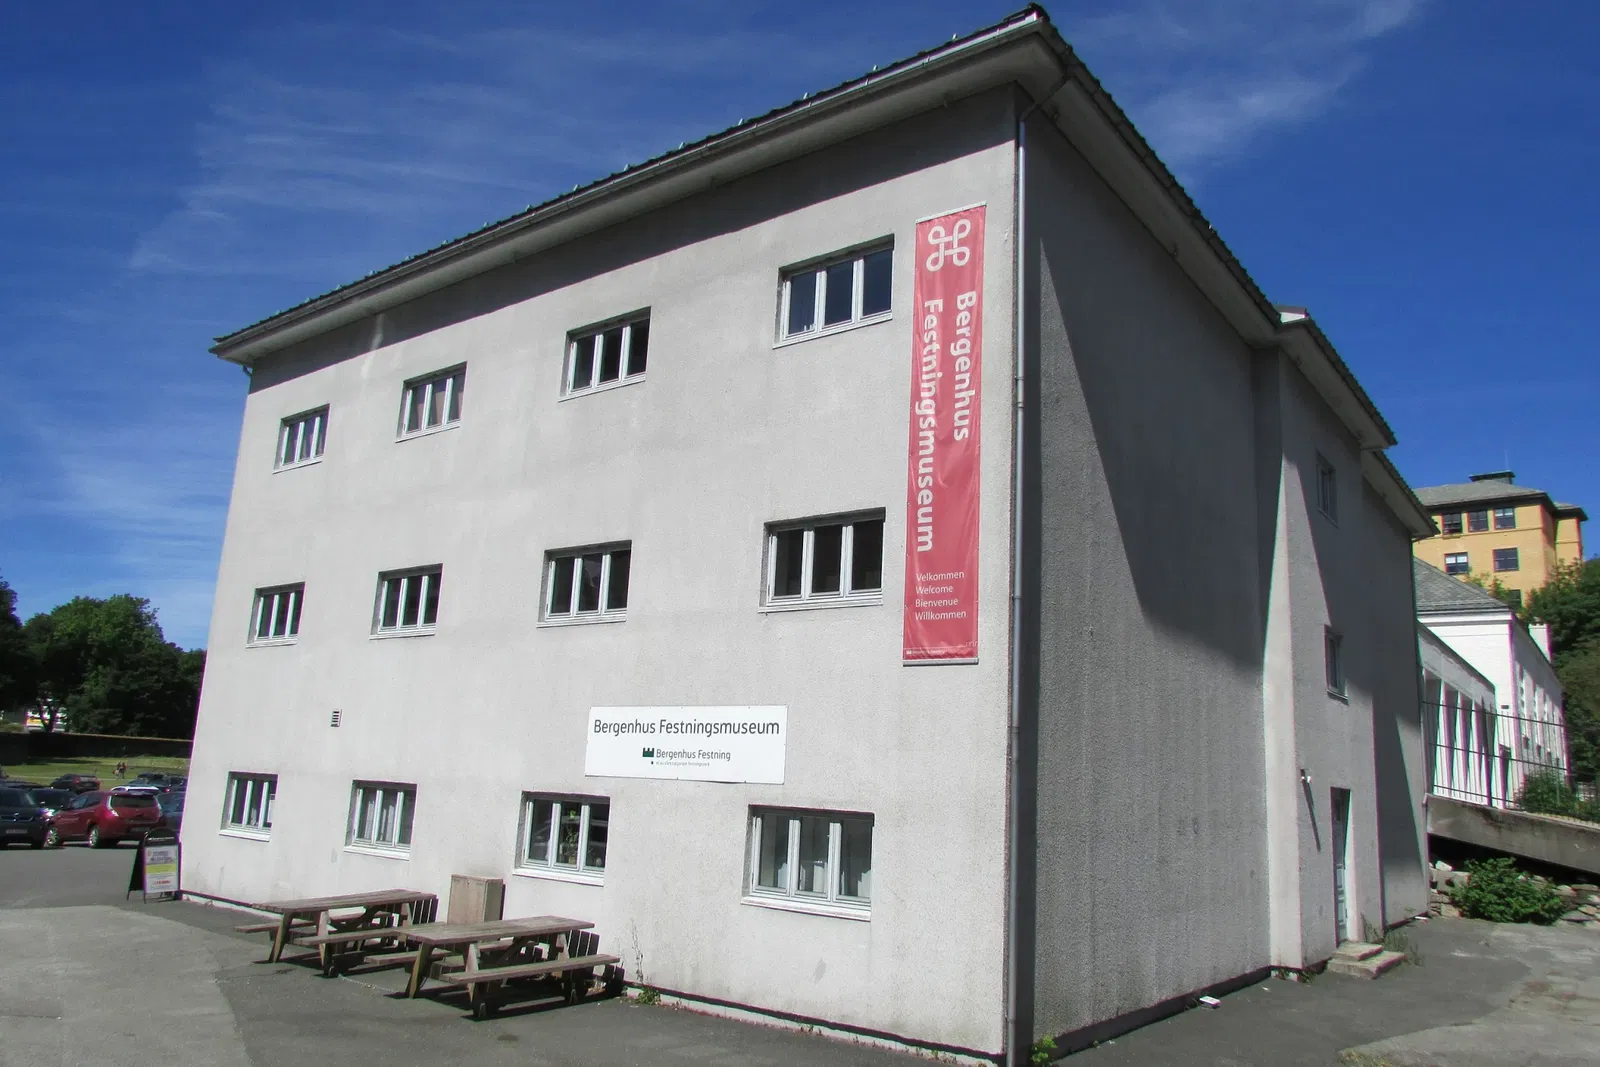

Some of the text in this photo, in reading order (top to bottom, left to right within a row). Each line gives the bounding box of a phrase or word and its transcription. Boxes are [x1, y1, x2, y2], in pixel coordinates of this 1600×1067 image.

[951, 292, 977, 441] Bergenhus
[915, 298, 943, 552] Festningsmuseum
[915, 571, 965, 582] Velkommen
[915, 585, 954, 594] Welcome
[915, 597, 959, 608] Bienvenue
[915, 611, 966, 621] Willkommen
[593, 719, 780, 738] Bergenhus Festningsmuseum
[656, 748, 731, 762] Bergenhus Festning
